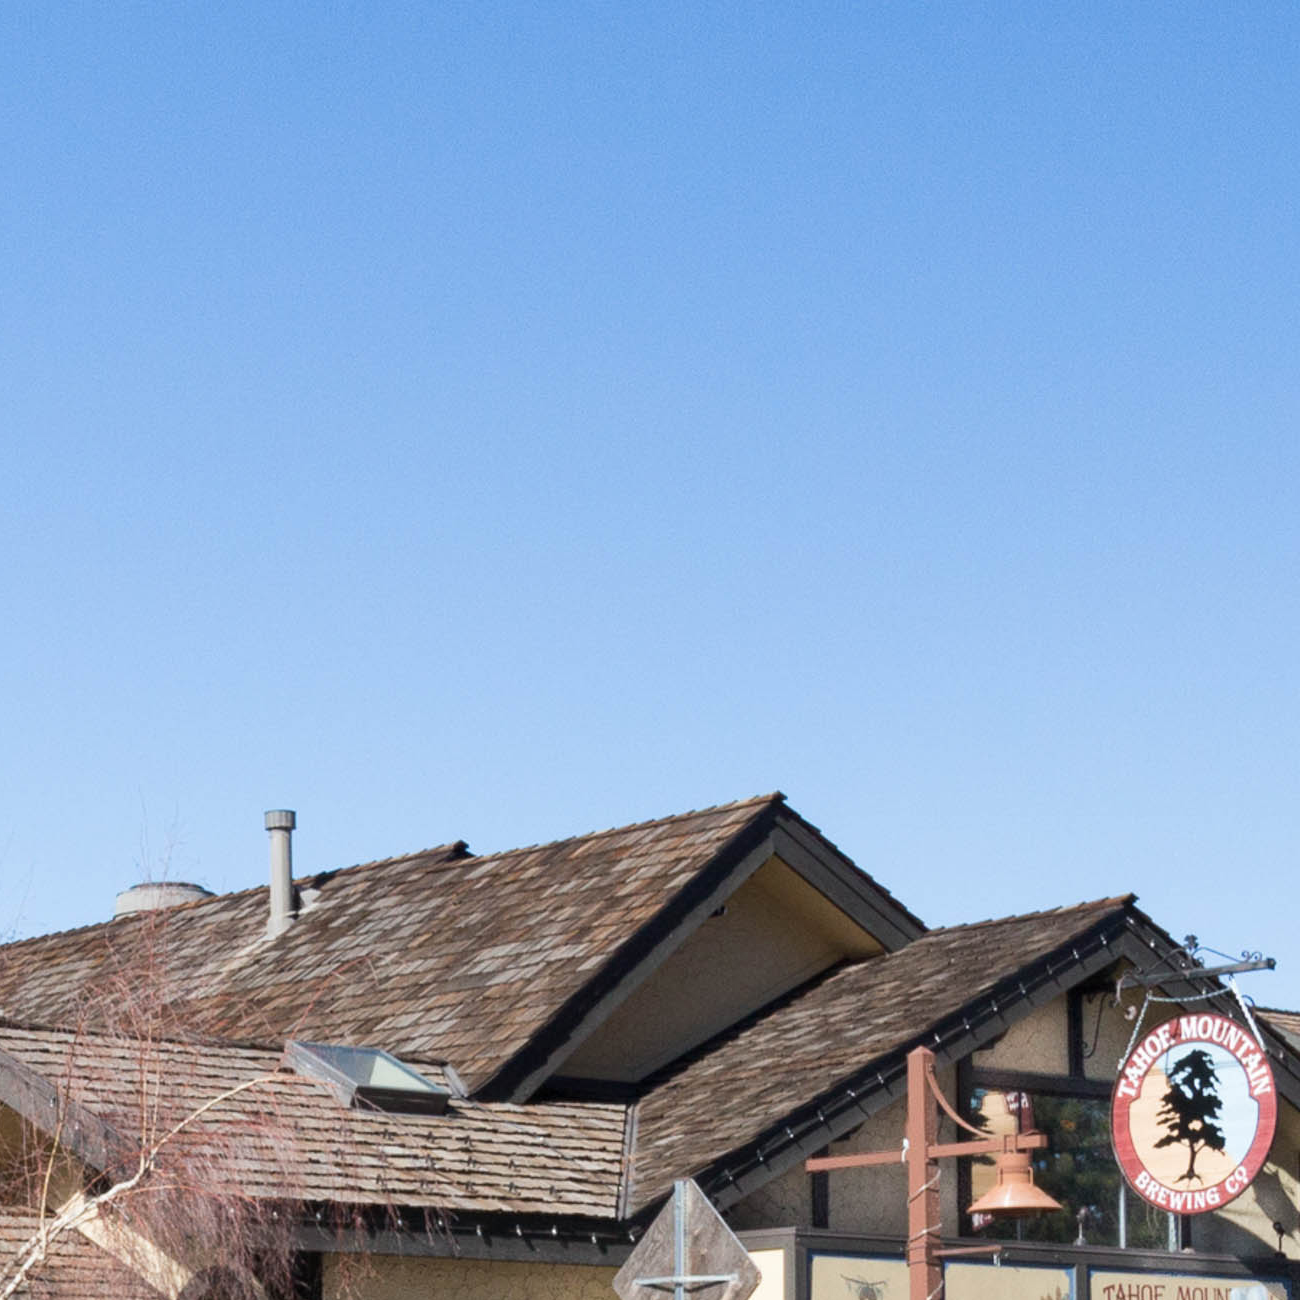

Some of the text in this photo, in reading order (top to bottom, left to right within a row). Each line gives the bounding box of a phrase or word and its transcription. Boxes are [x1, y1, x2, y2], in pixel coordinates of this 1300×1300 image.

[1118, 1016, 1271, 1098] TAHOE MOUNTAIN
[1134, 1171, 1220, 1211] BREWING
